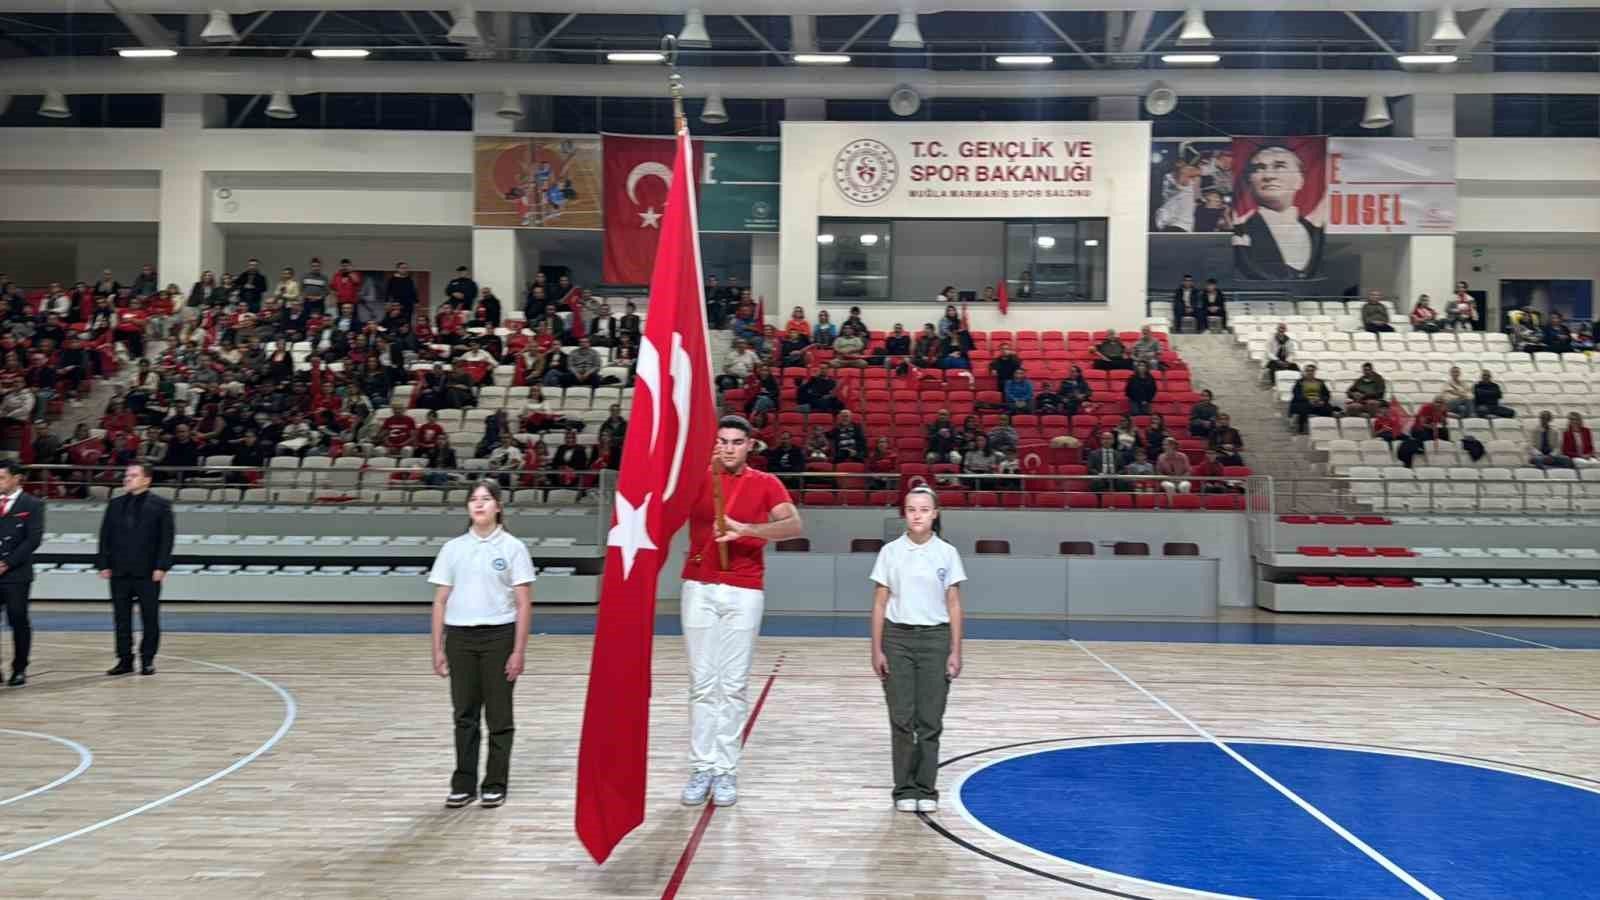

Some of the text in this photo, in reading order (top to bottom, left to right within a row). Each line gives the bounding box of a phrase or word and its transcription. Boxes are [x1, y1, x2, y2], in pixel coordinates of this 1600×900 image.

[909, 137, 1092, 162] T.C. GENÇLİK VE
[910, 165, 970, 182] SPOR
[975, 161, 1092, 182] BAKANLIĞI
[1012, 190, 1042, 198] SPOR
